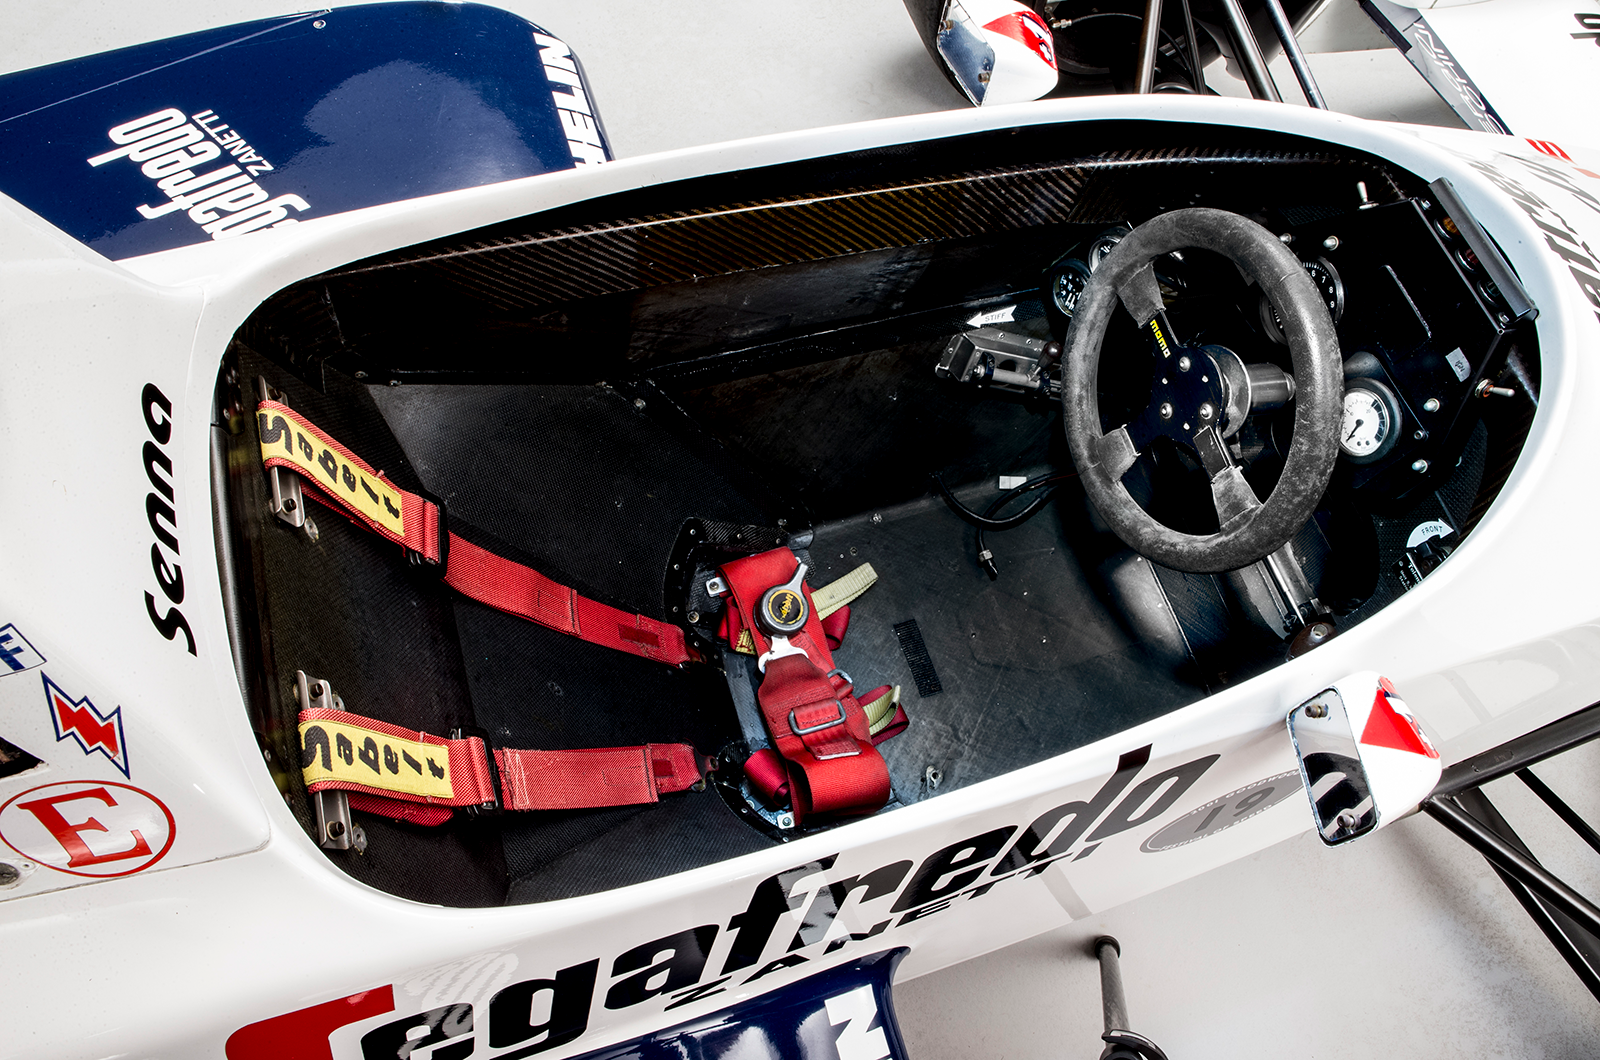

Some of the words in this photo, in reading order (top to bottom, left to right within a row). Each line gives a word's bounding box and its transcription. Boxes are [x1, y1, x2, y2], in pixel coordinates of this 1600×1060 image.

[87, 107, 311, 241] gafredo
[191, 109, 274, 176] ZANETTI
[984, 311, 1008, 324] STIFF
[1149, 318, 1172, 358] momo
[260, 413, 402, 519] Sabelt
[141, 382, 197, 657] Senna
[1421, 525, 1443, 536] FRONT
[301, 725, 446, 782] Sabelt
[16, 787, 153, 869] E
[664, 844, 1102, 1011] ZANETTI
